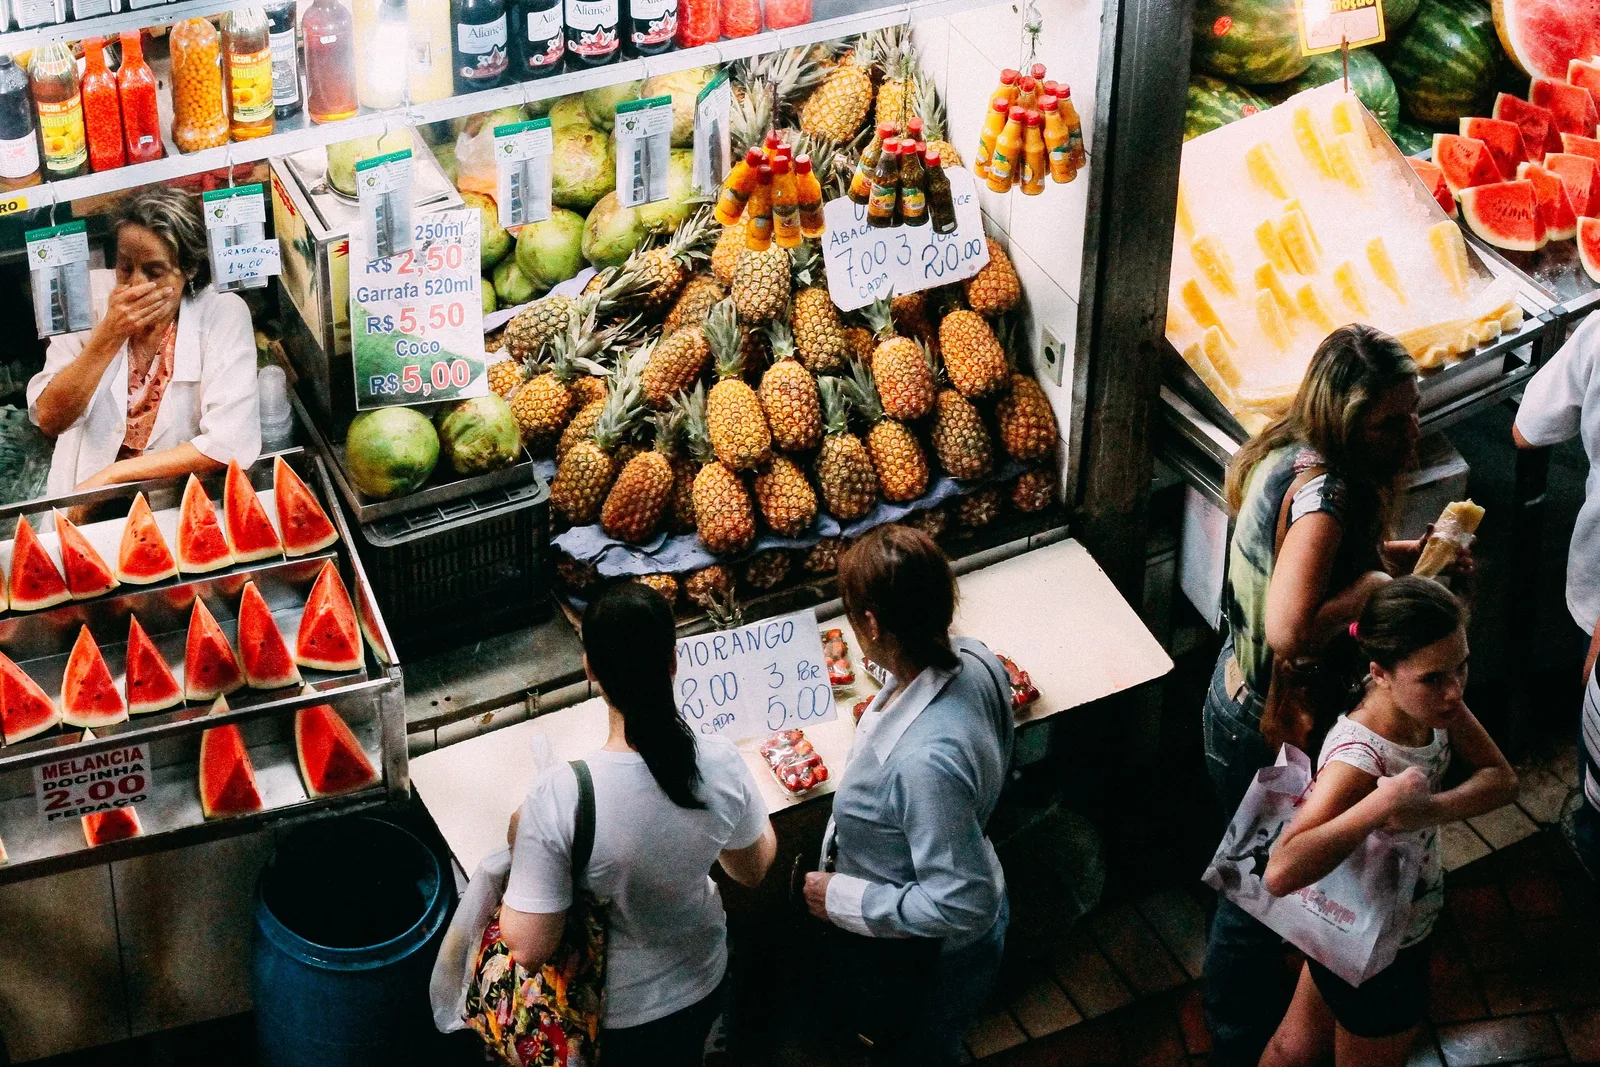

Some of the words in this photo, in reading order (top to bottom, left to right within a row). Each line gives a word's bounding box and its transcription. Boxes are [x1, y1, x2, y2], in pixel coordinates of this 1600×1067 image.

[572, 4, 611, 16] Aliança
[468, 24, 504, 39] Aliança
[231, 53, 251, 63] LICOR
[40, 103, 60, 113] LICOR
[415, 221, 464, 241] 250ml
[830, 223, 880, 250] ABACA
[366, 256, 392, 274] R$
[397, 244, 463, 277] 2,50
[896, 234, 912, 266] 3
[921, 238, 981, 279] 20.00
[228, 258, 263, 274] 14.00
[835, 241, 887, 288] 7.00
[357, 282, 419, 303] Garrafa
[425, 276, 473, 296] 520ml
[859, 273, 888, 299] CADA
[367, 315, 394, 334] R$
[399, 302, 464, 335] 5,50
[396, 340, 440, 357] Coco
[371, 374, 398, 394] R$
[403, 360, 470, 396] 5,00
[676, 621, 794, 667] MORANGO
[764, 662, 784, 689] 3
[797, 660, 820, 681] POR
[678, 672, 738, 720] 2.00
[767, 684, 831, 731] 5.00
[701, 713, 735, 735] CADA
[42, 747, 144, 780] MELANCIA
[43, 763, 145, 791] DOCINHA
